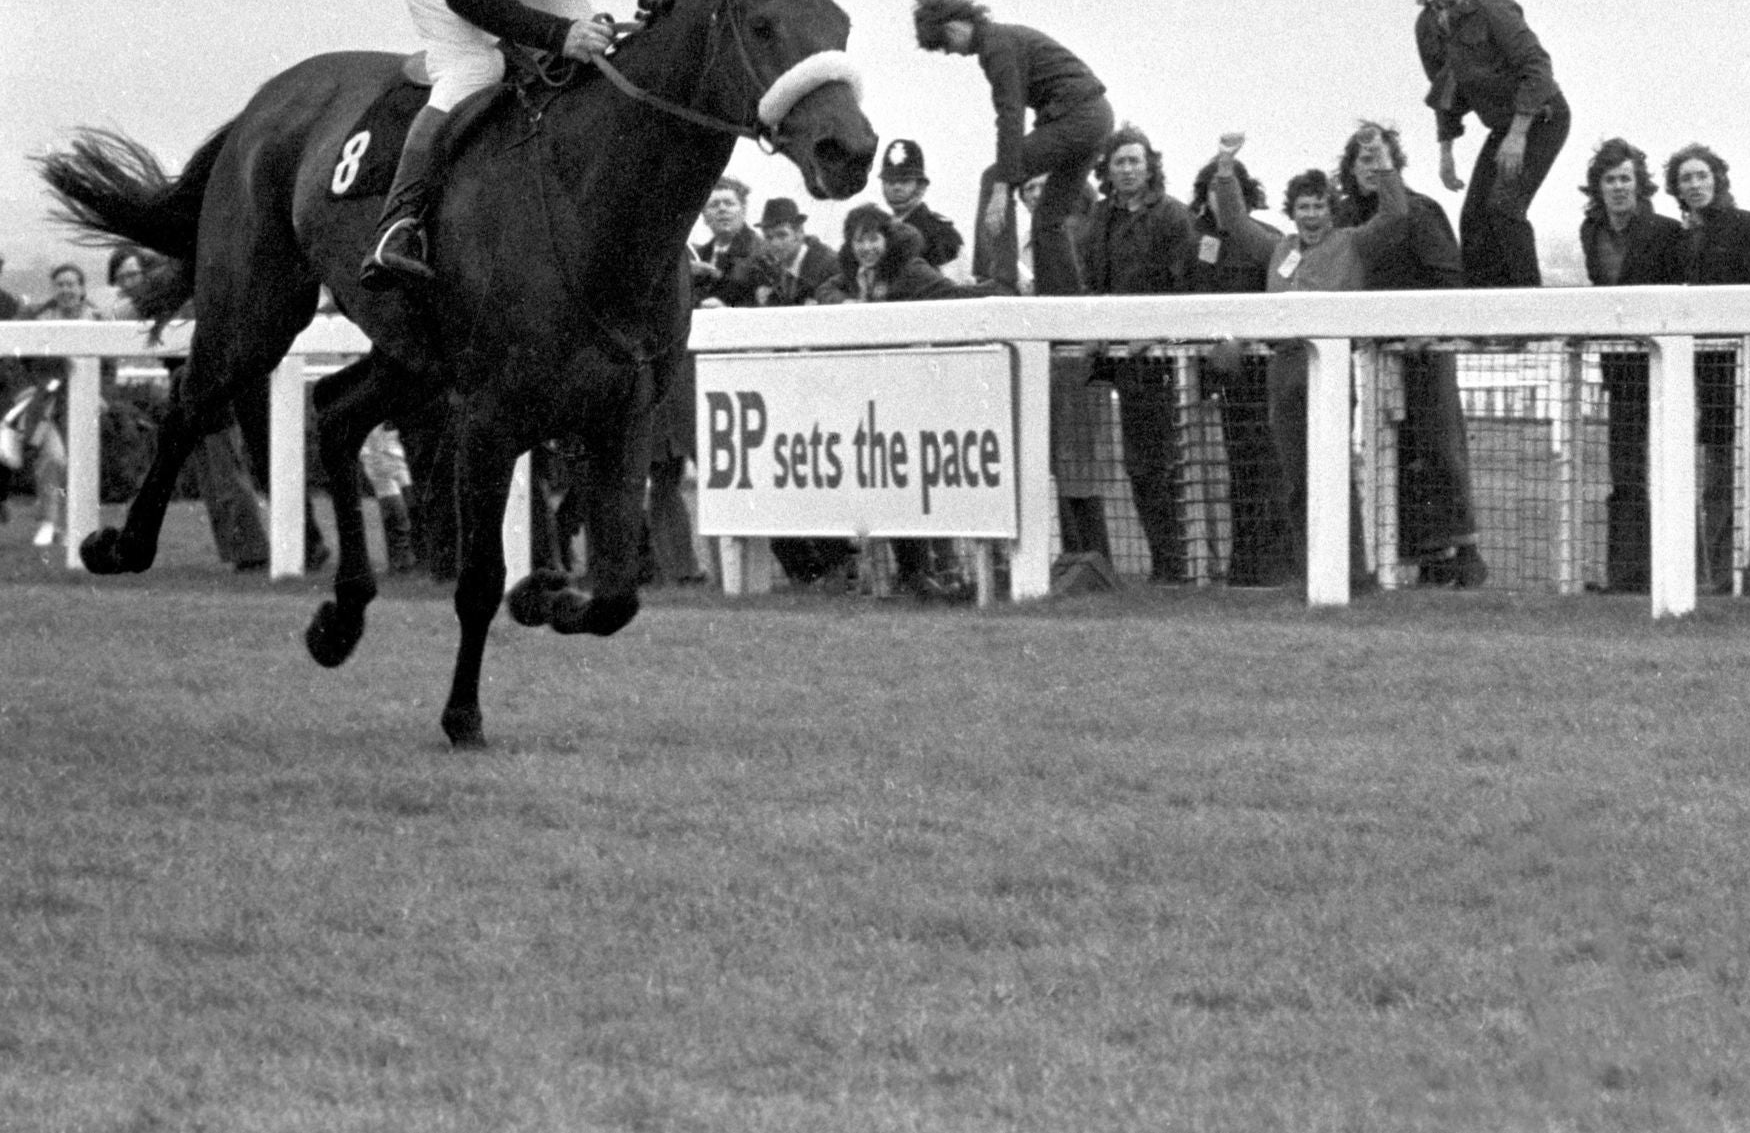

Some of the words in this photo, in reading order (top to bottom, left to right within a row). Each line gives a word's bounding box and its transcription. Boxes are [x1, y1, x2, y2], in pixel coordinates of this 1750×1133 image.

[331, 129, 371, 195] 8
[705, 390, 768, 490] BP
[773, 420, 844, 490] sets
[853, 399, 909, 489] the
[919, 428, 1001, 515] pace
